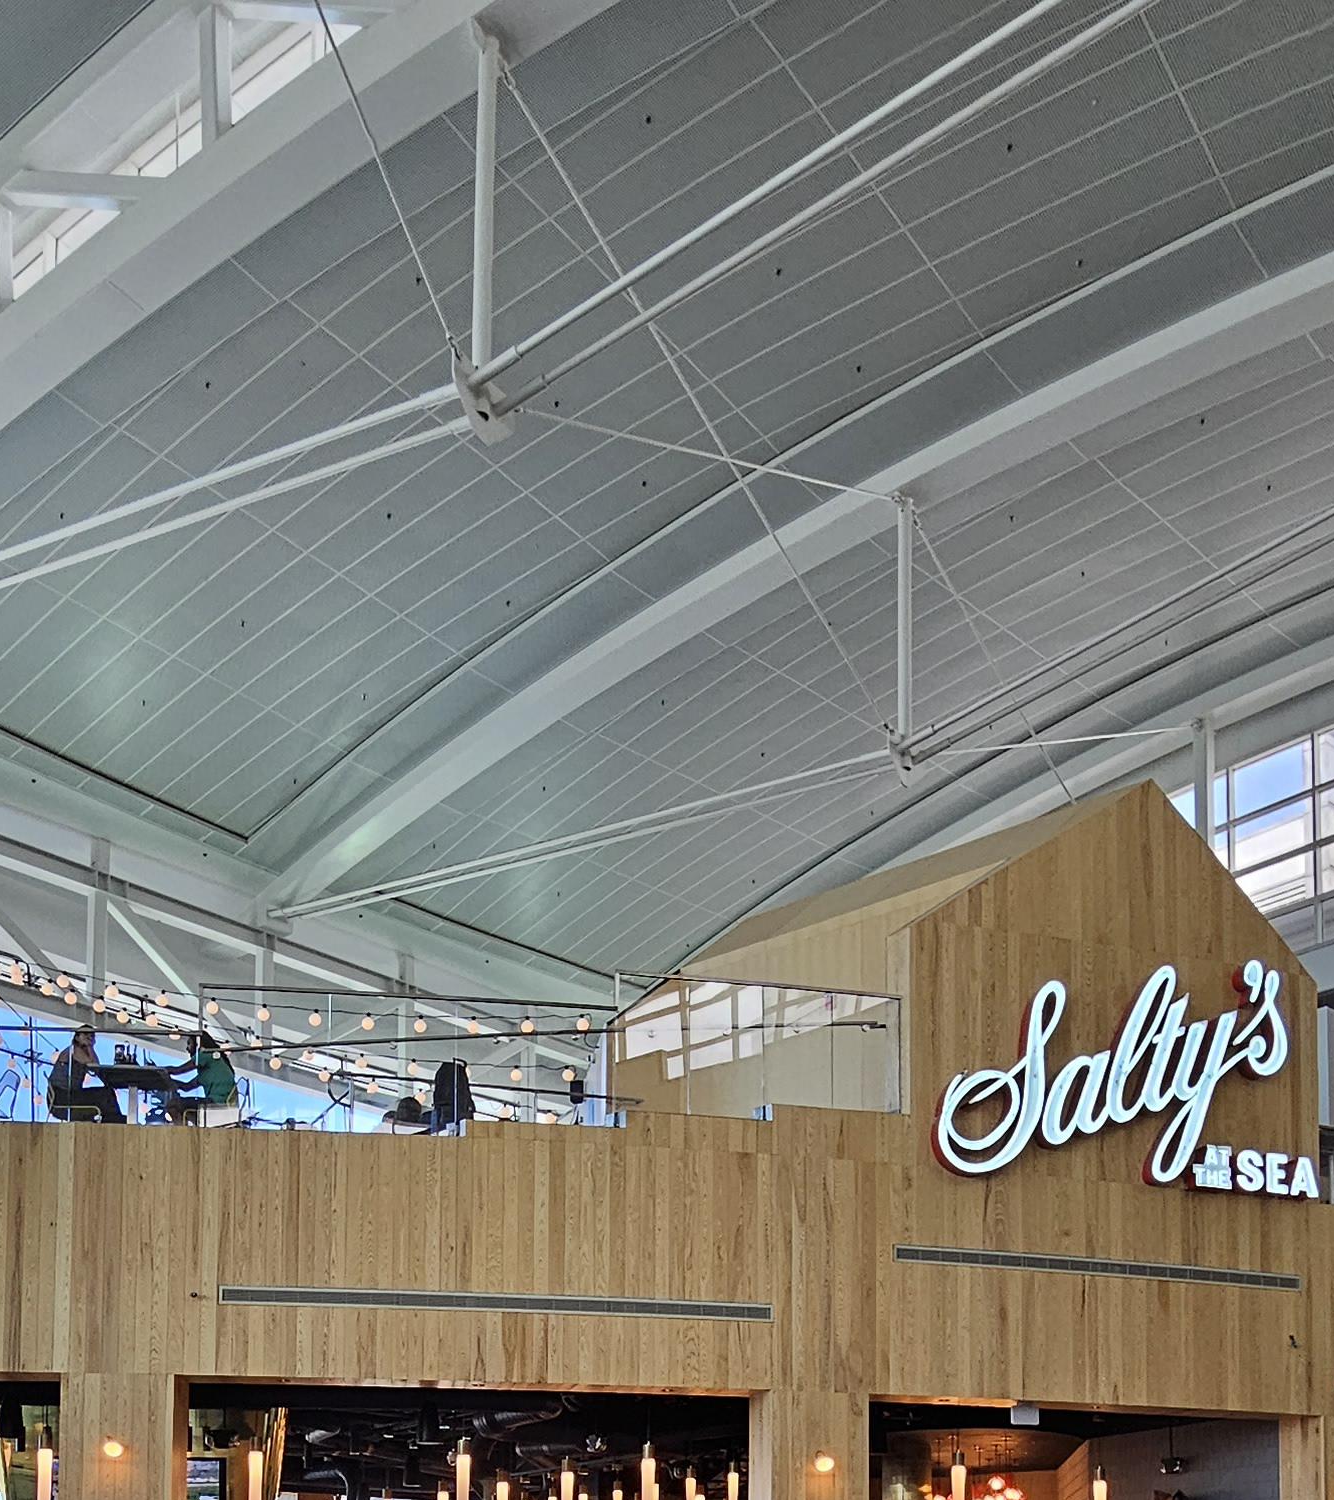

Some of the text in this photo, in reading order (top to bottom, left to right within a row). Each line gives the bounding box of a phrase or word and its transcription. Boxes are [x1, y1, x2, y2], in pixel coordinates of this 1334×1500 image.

[937, 959, 1289, 1184] Salty's
[1193, 1144, 1319, 1198] AT THE SEA
